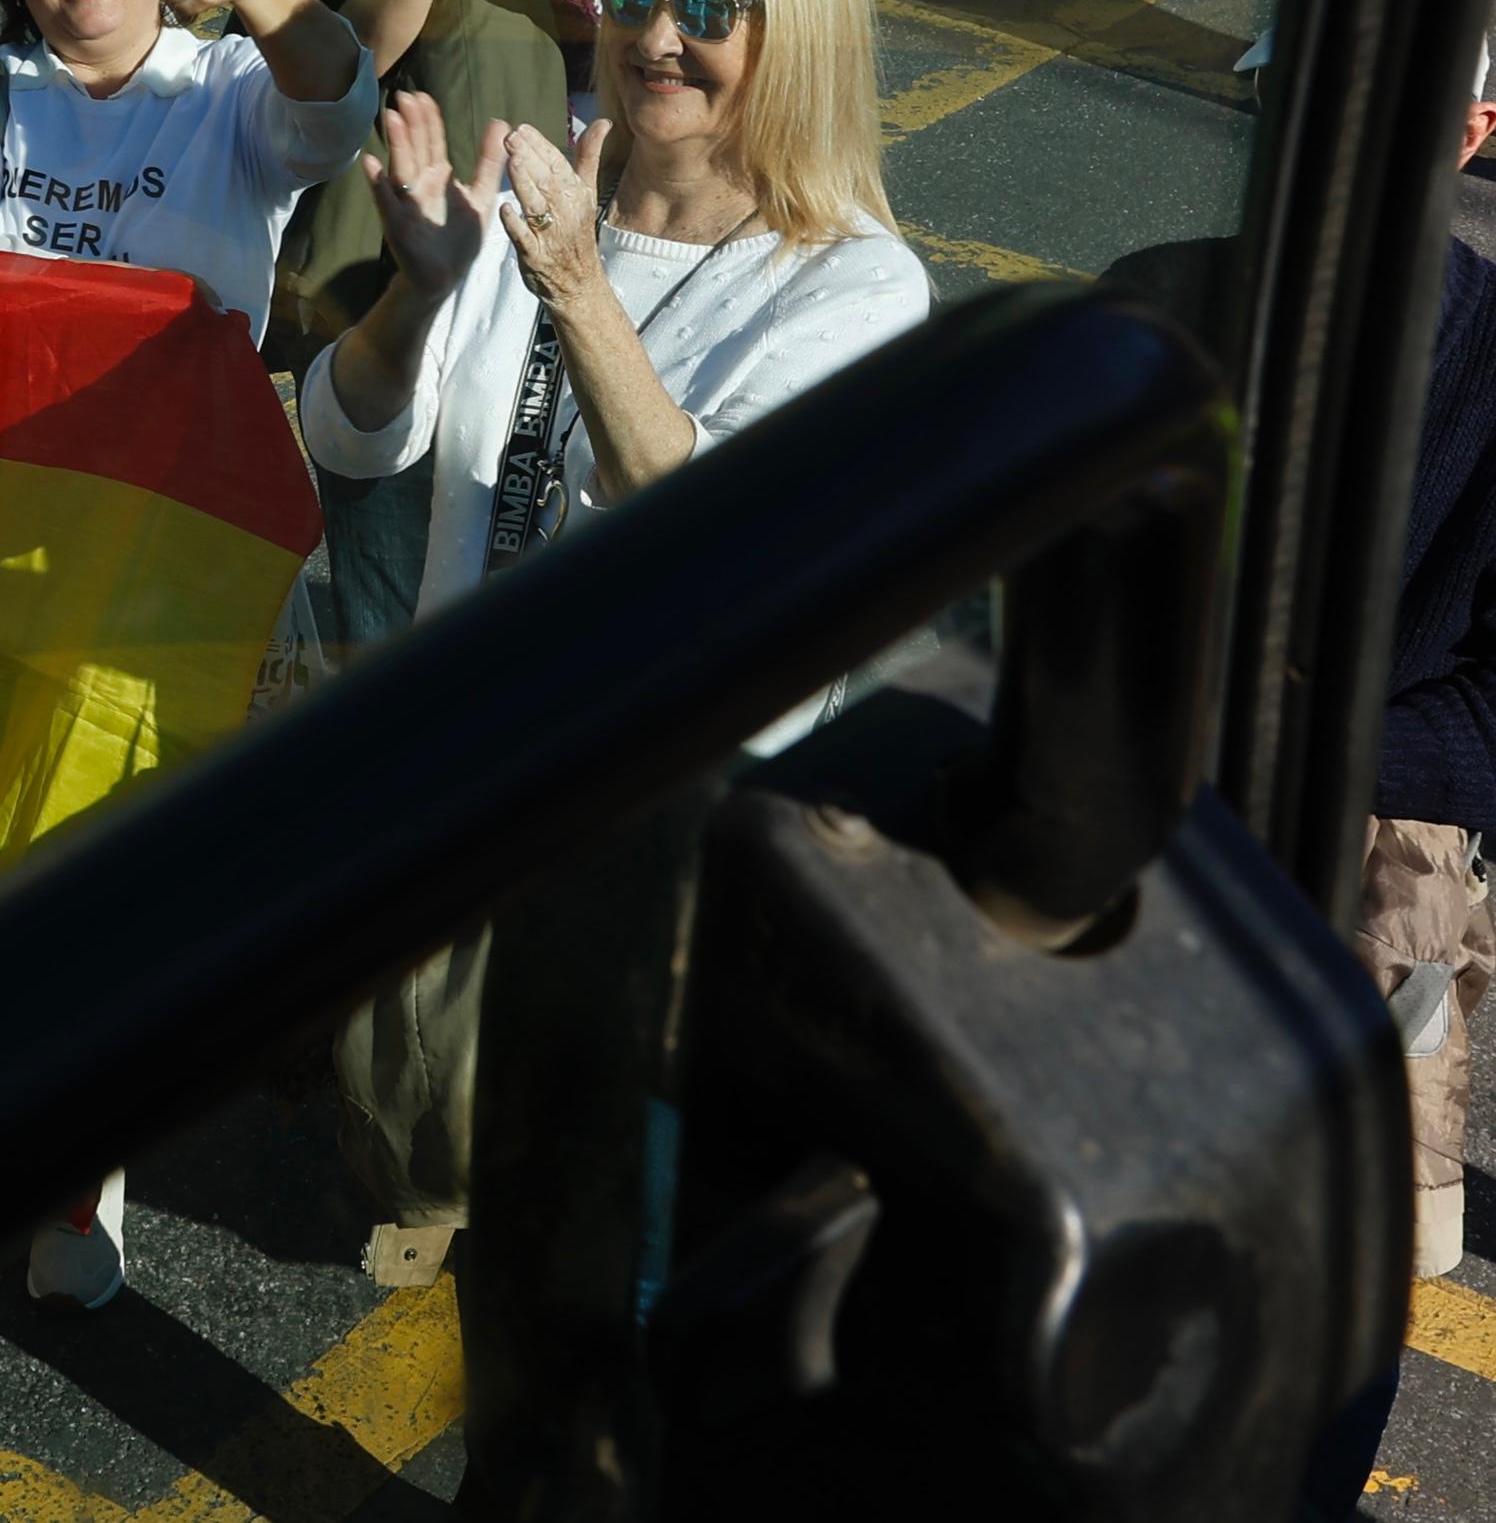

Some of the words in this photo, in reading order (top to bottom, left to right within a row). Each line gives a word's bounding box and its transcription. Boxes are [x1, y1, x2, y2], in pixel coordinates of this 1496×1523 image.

[22, 215, 102, 257] SER
[514, 338, 560, 438] BIMBA
[492, 451, 537, 554] BIMBA
